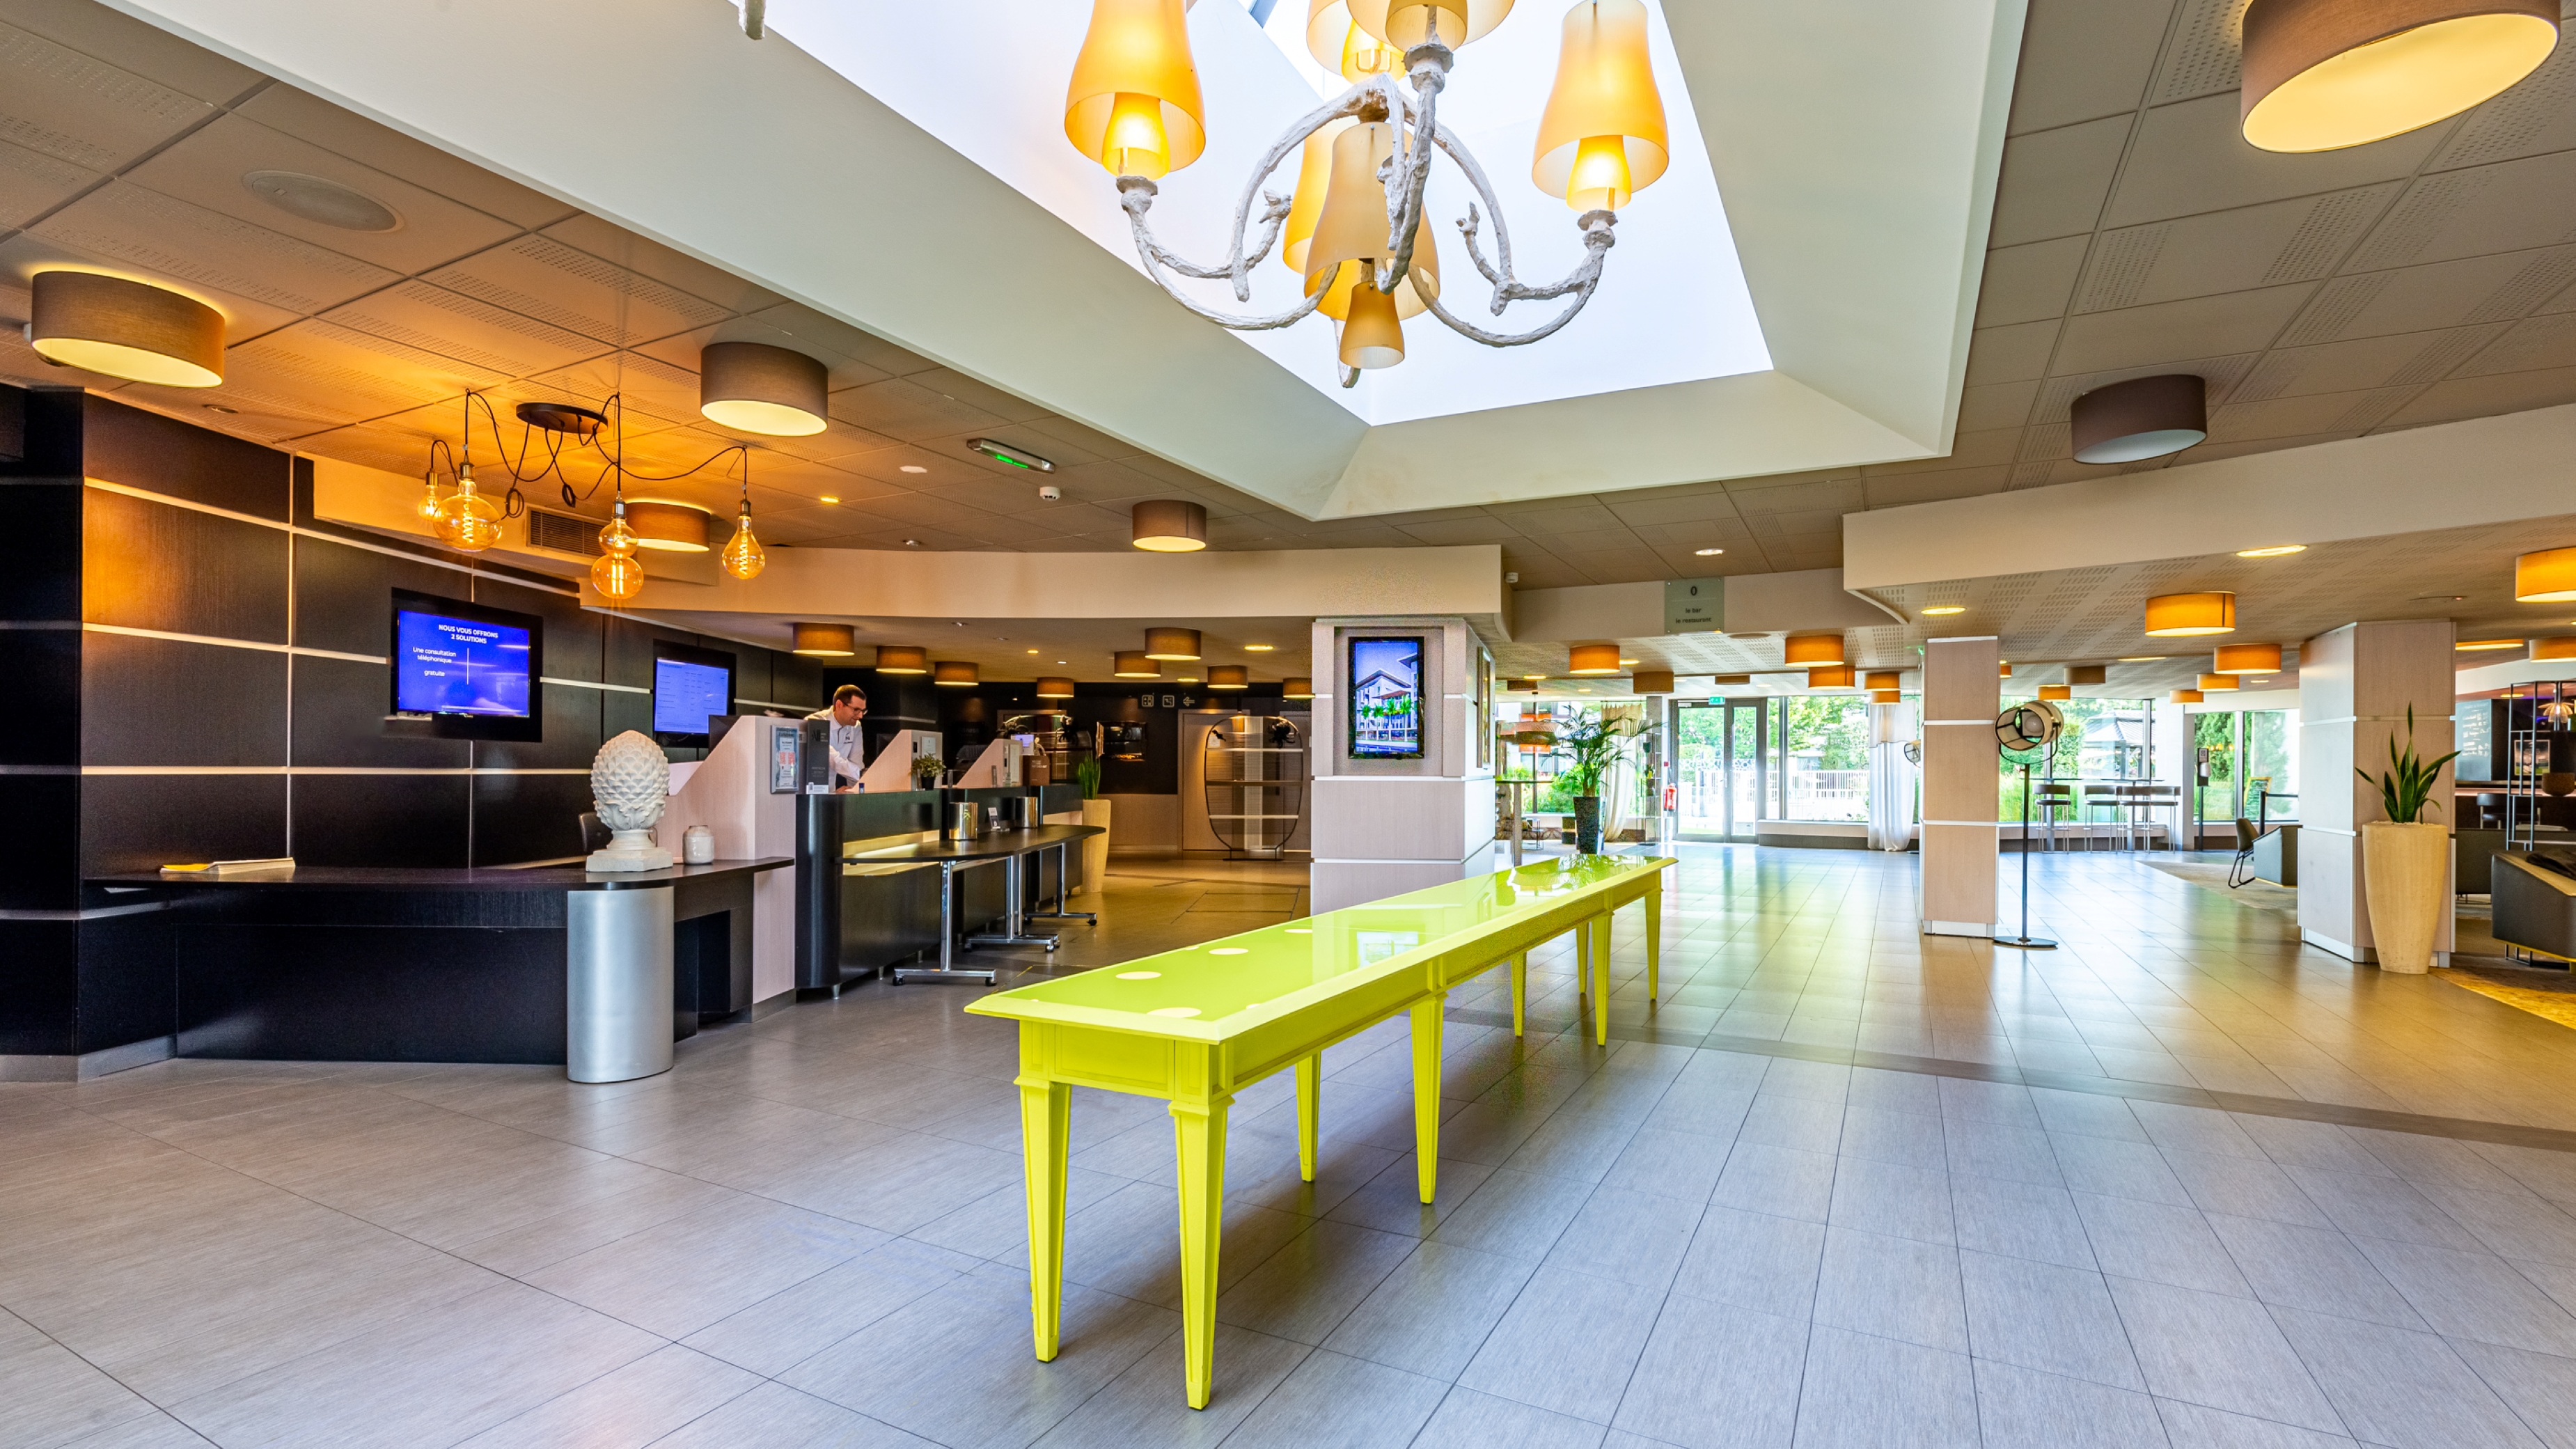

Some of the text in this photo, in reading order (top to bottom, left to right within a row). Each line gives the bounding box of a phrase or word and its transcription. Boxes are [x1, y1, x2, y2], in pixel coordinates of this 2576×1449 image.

[456, 634, 487, 644] SOLUTIONS
[473, 629, 498, 639] OFFRONS
[417, 655, 452, 664] téléphonique
